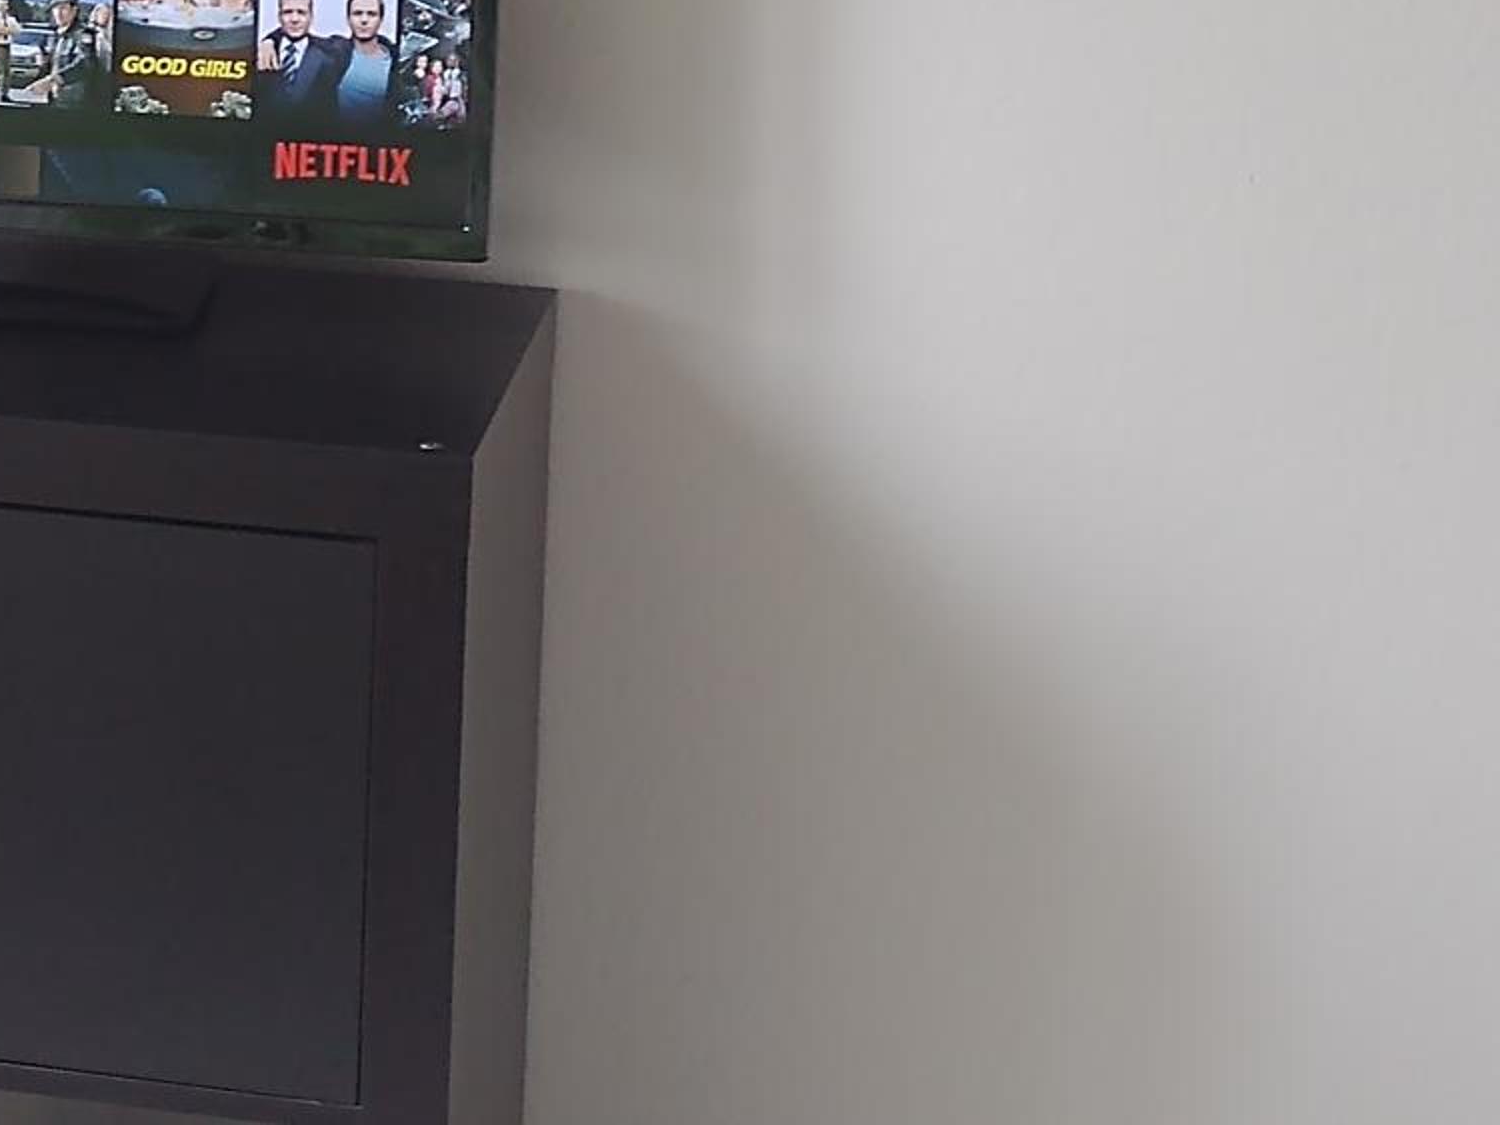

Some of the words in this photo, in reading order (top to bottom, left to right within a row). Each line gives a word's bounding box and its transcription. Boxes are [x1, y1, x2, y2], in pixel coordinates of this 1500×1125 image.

[122, 55, 187, 77] GOOD
[189, 58, 248, 80] GIRLS
[274, 141, 414, 187] NETFLIX
